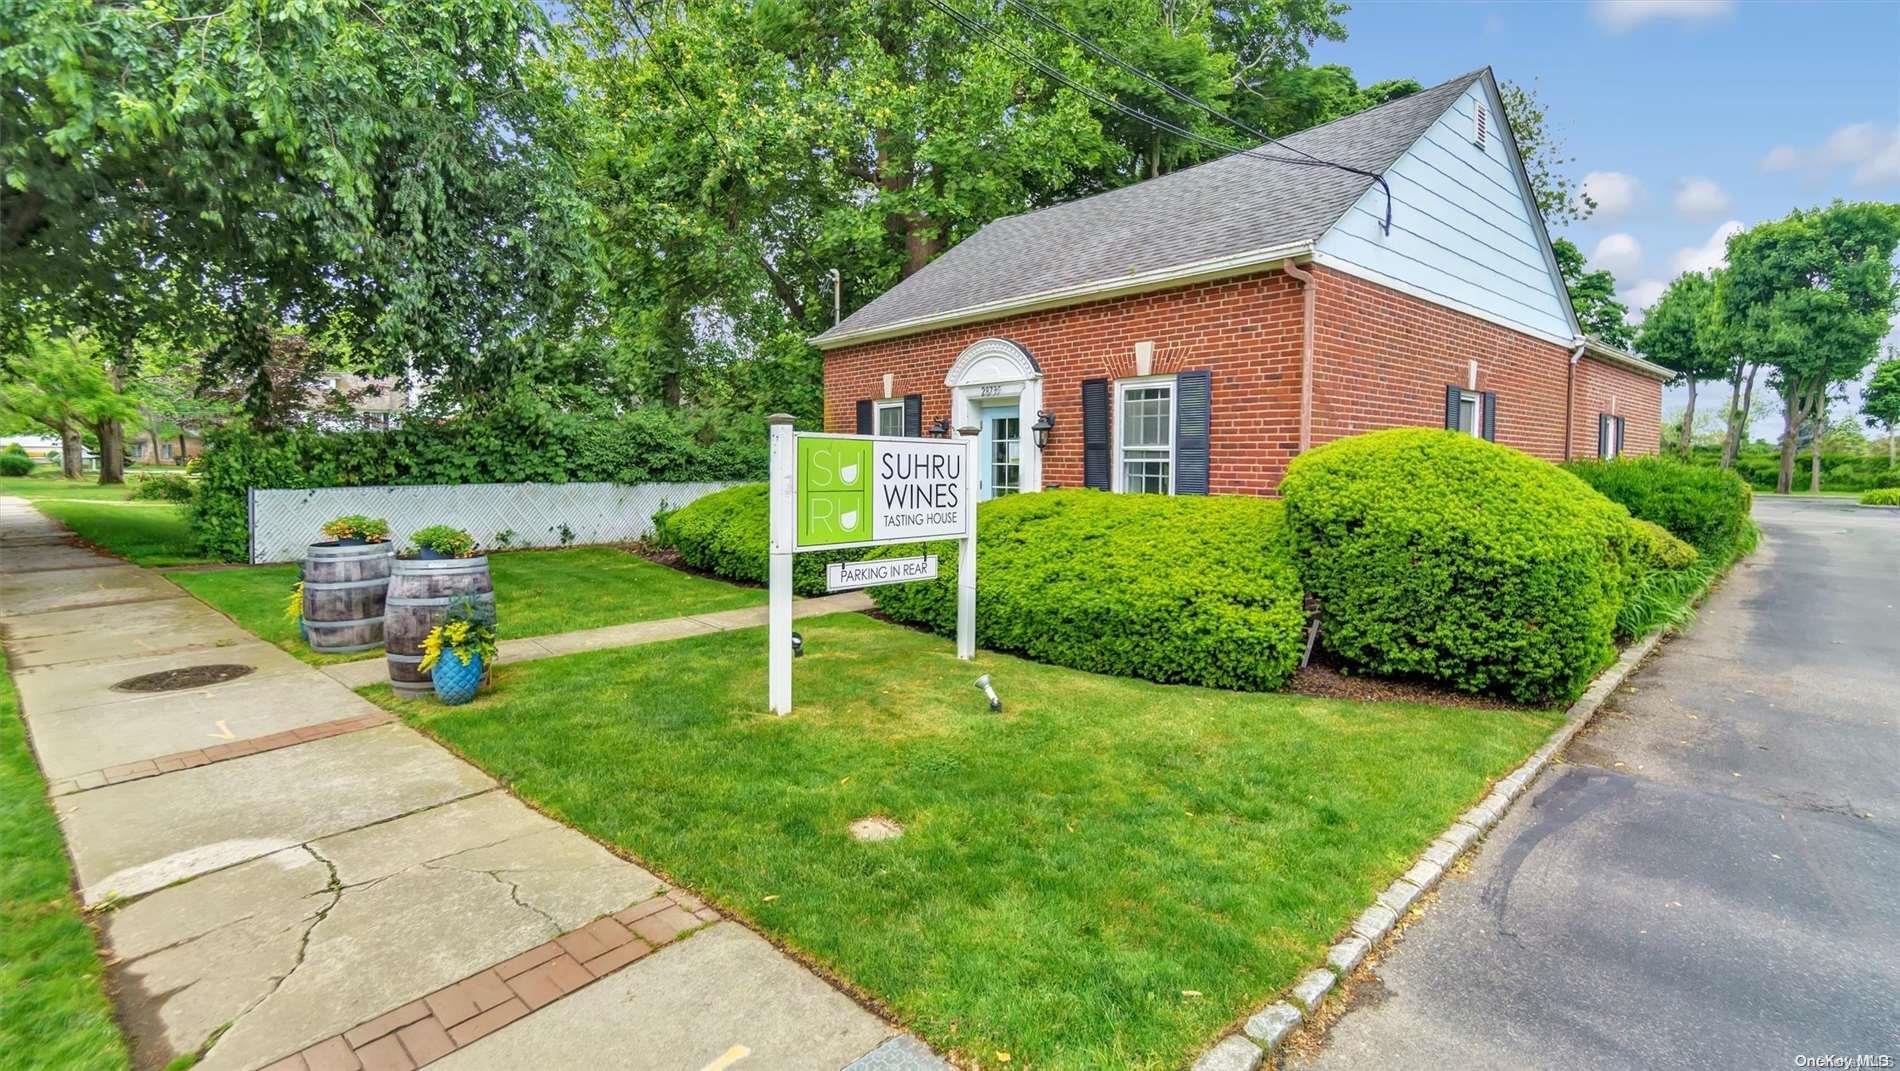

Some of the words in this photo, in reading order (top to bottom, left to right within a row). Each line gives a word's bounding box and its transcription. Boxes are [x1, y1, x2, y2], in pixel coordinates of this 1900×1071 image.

[881, 452, 960, 480] SUHRU
[883, 483, 958, 509] WINES
[884, 513, 923, 527] TASTING
[926, 511, 958, 525] HOUSE
[840, 566, 888, 583] PARKING
[890, 565, 900, 577] IN
[903, 562, 928, 576] REAR
